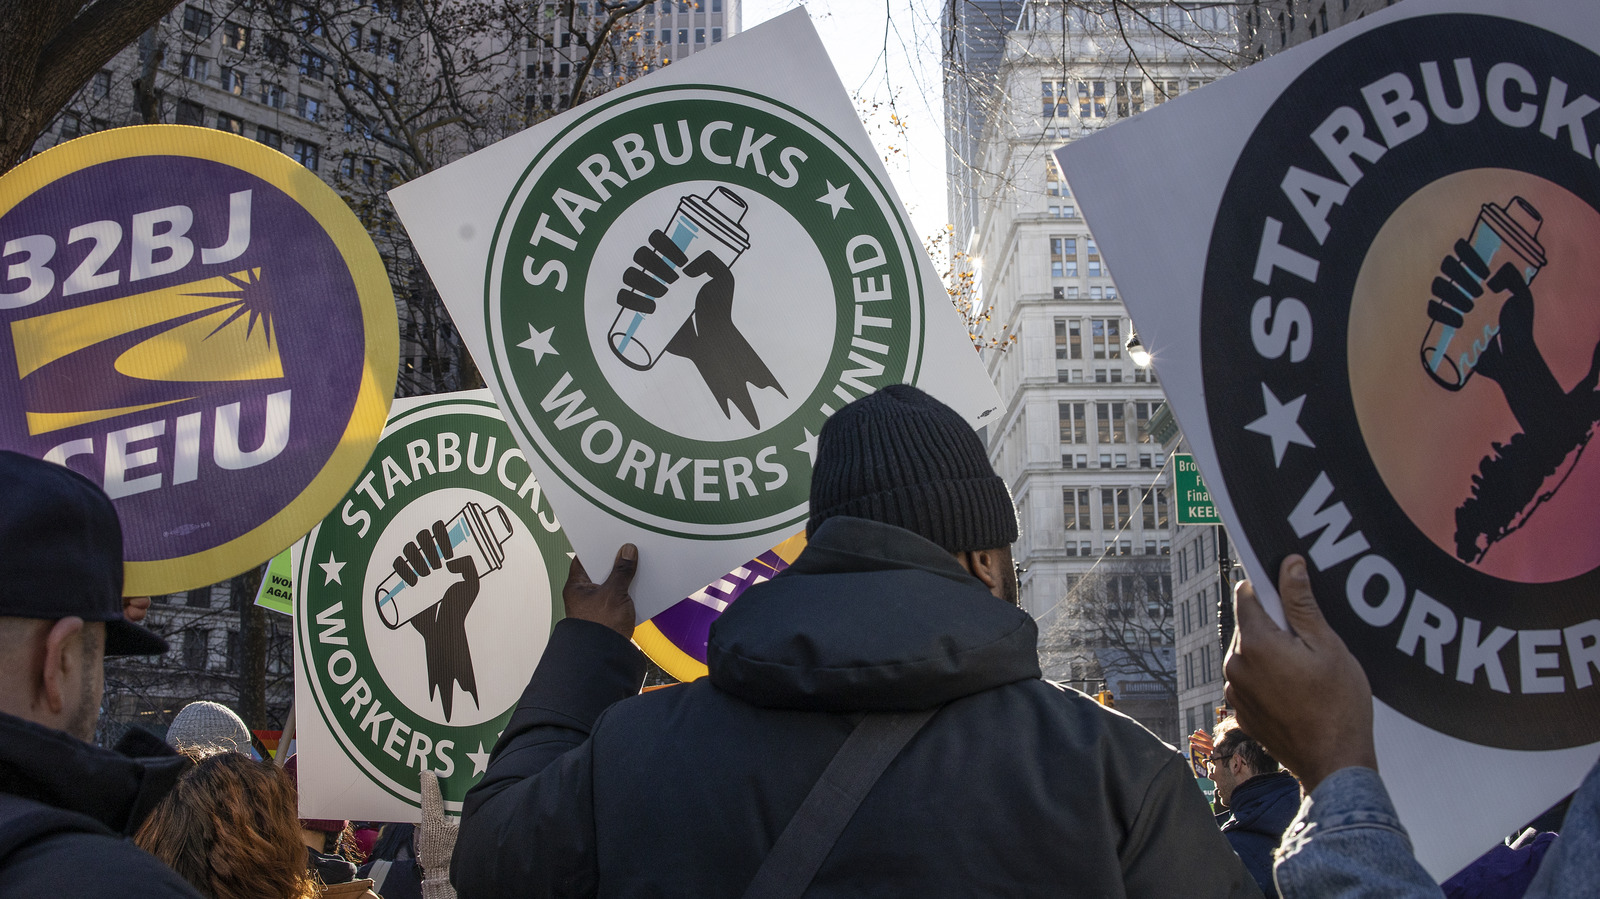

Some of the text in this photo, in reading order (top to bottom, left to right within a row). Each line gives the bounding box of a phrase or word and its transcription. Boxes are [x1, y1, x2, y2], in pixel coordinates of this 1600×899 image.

[0, 189, 252, 309] 32BJ
[523, 119, 808, 292] STARBUCKS
[1250, 57, 1600, 363] STARBUCK
[540, 371, 788, 501] WORKERS
[1186, 489, 1212, 501] Fina
[266, 587, 292, 601] AGAI
[315, 601, 455, 778] WORKERS
